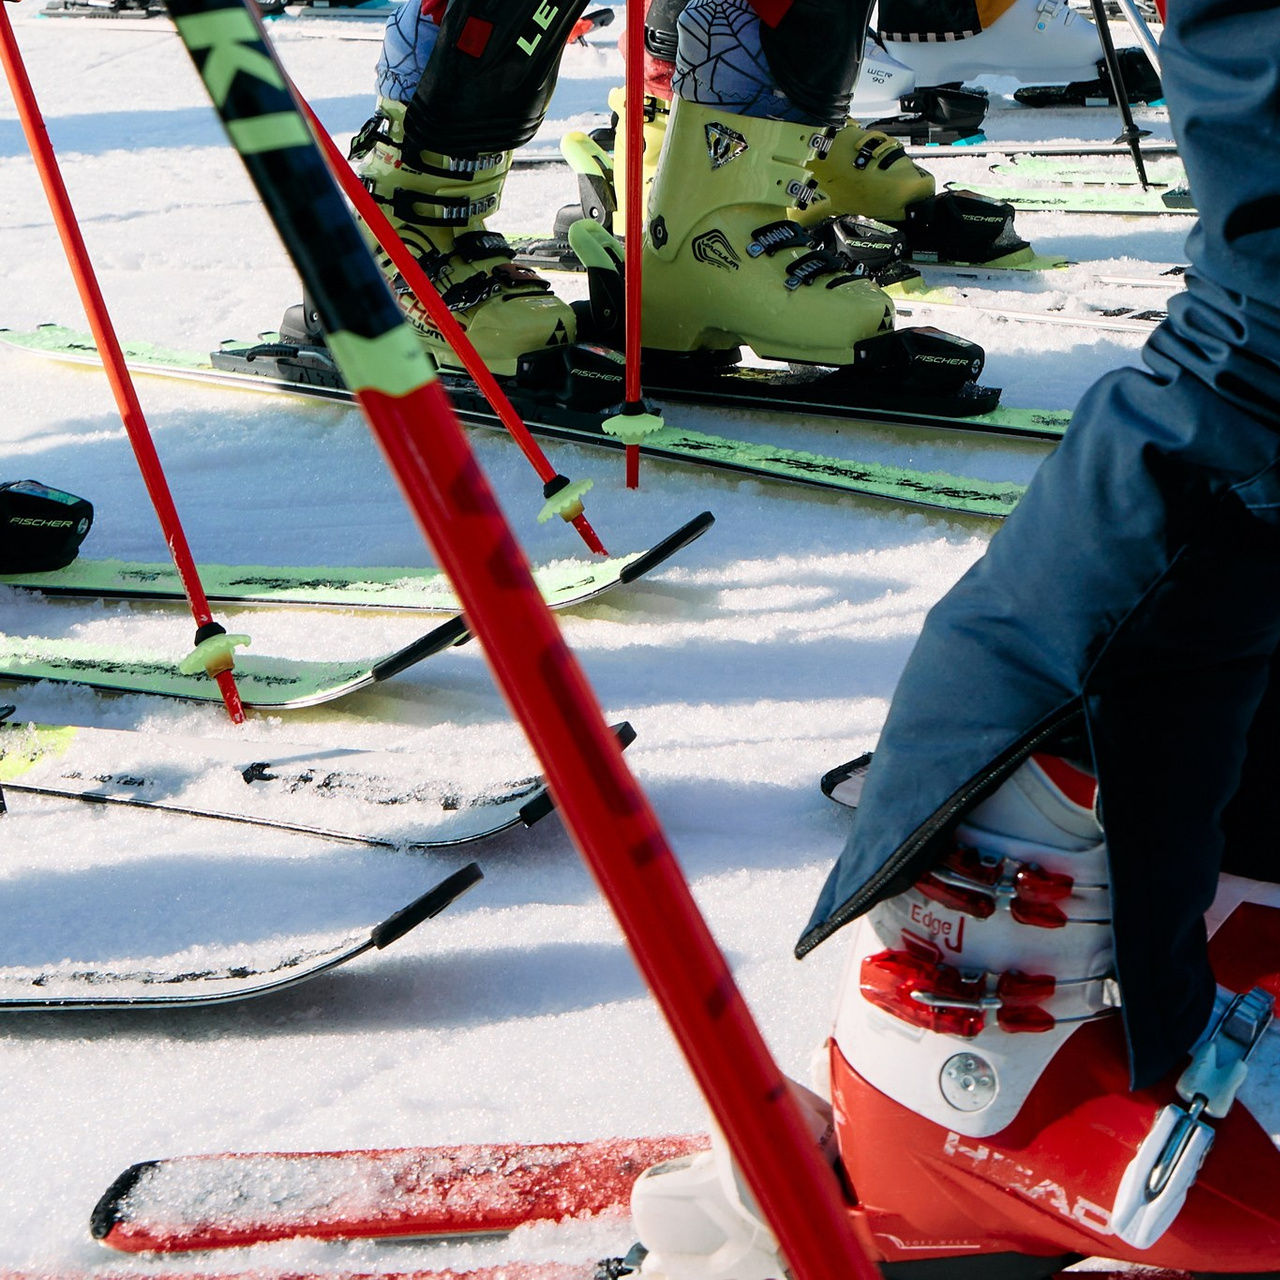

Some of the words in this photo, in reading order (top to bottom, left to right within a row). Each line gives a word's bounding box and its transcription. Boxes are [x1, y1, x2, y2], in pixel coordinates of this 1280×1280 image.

[867, 68, 893, 78] WCR
[845, 240, 892, 251] FISCHER
[701, 240, 740, 272] VACUUM
[914, 354, 969, 367] FISCHER
[571, 368, 623, 382] FISCHER
[9, 517, 74, 528] FISCHER
[911, 903, 952, 936] Edge
[945, 916, 965, 953] J
